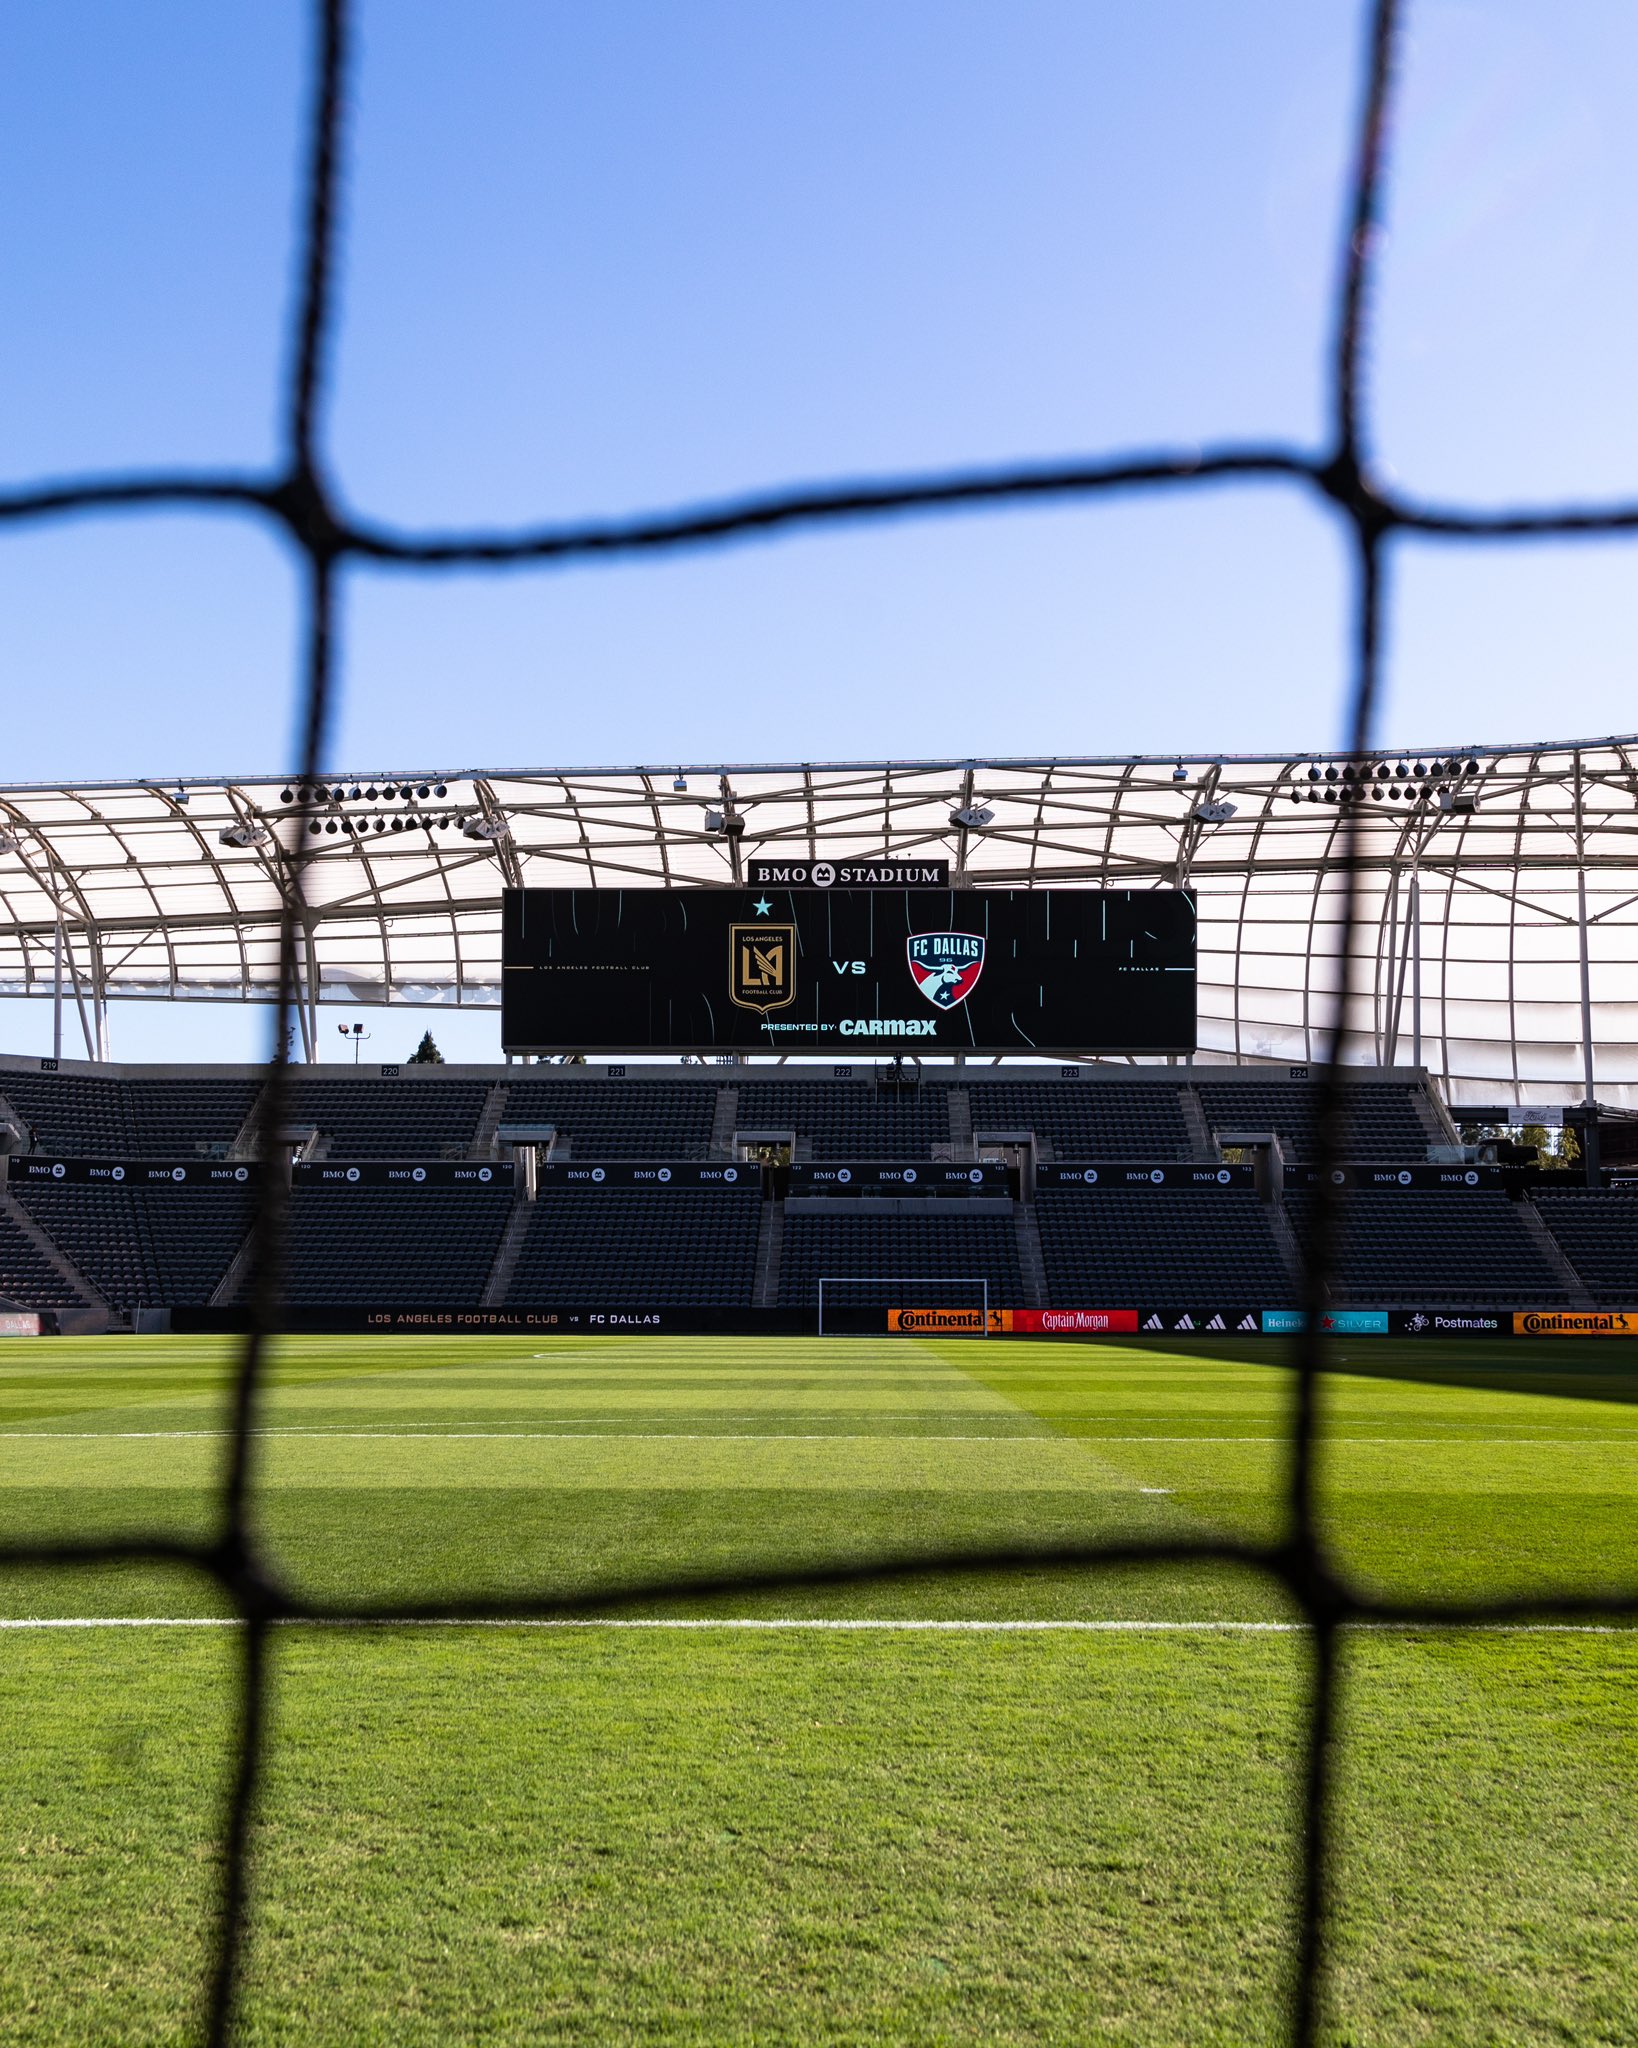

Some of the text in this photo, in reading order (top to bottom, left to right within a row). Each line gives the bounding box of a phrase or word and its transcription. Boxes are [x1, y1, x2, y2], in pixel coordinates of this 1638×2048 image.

[757, 867, 940, 882] BMO STADIUM
[913, 937, 979, 958] FC DALLAS
[832, 960, 866, 975] VS
[760, 1022, 818, 1032] PRESENTED
[42, 1061, 59, 1070] 219
[383, 1067, 398, 1076] 220
[610, 1067, 624, 1076] 221
[835, 1068, 851, 1076] 222
[1063, 1068, 1079, 1077] 223
[1291, 1069, 1307, 1078] 224
[28, 1165, 51, 1174] BMO
[89, 1168, 111, 1177] BMO
[148, 1170, 171, 1178] BMO
[210, 1170, 233, 1178] BMO
[322, 1170, 345, 1179] BMO
[388, 1170, 411, 1179] BMO
[454, 1170, 477, 1179] BMO
[567, 1171, 590, 1179] BMO
[633, 1171, 656, 1179] BMO
[700, 1171, 722, 1179] BMO
[813, 1172, 836, 1180] BMO
[879, 1172, 902, 1180] BMO
[945, 1172, 968, 1180] BMO
[1060, 1172, 1082, 1180] BMO
[1126, 1172, 1149, 1181] BMO
[1192, 1172, 1215, 1181] BMO
[1373, 1173, 1396, 1182] BMO
[1440, 1174, 1463, 1182] BMO
[367, 1314, 392, 1324] LOS
[396, 1314, 453, 1324] ANGELES
[457, 1314, 521, 1324] FOOTBALL
[526, 1314, 559, 1324] CLUB
[589, 1314, 605, 1324] FC
[609, 1314, 661, 1324] DALLAS
[898, 1311, 985, 1330] Continental
[1042, 1312, 1109, 1330] Captain Morgan
[1268, 1319, 1381, 1328] Heinek SILVER
[1434, 1316, 1498, 1329] Postmates
[1523, 1313, 1614, 1334] Continental
